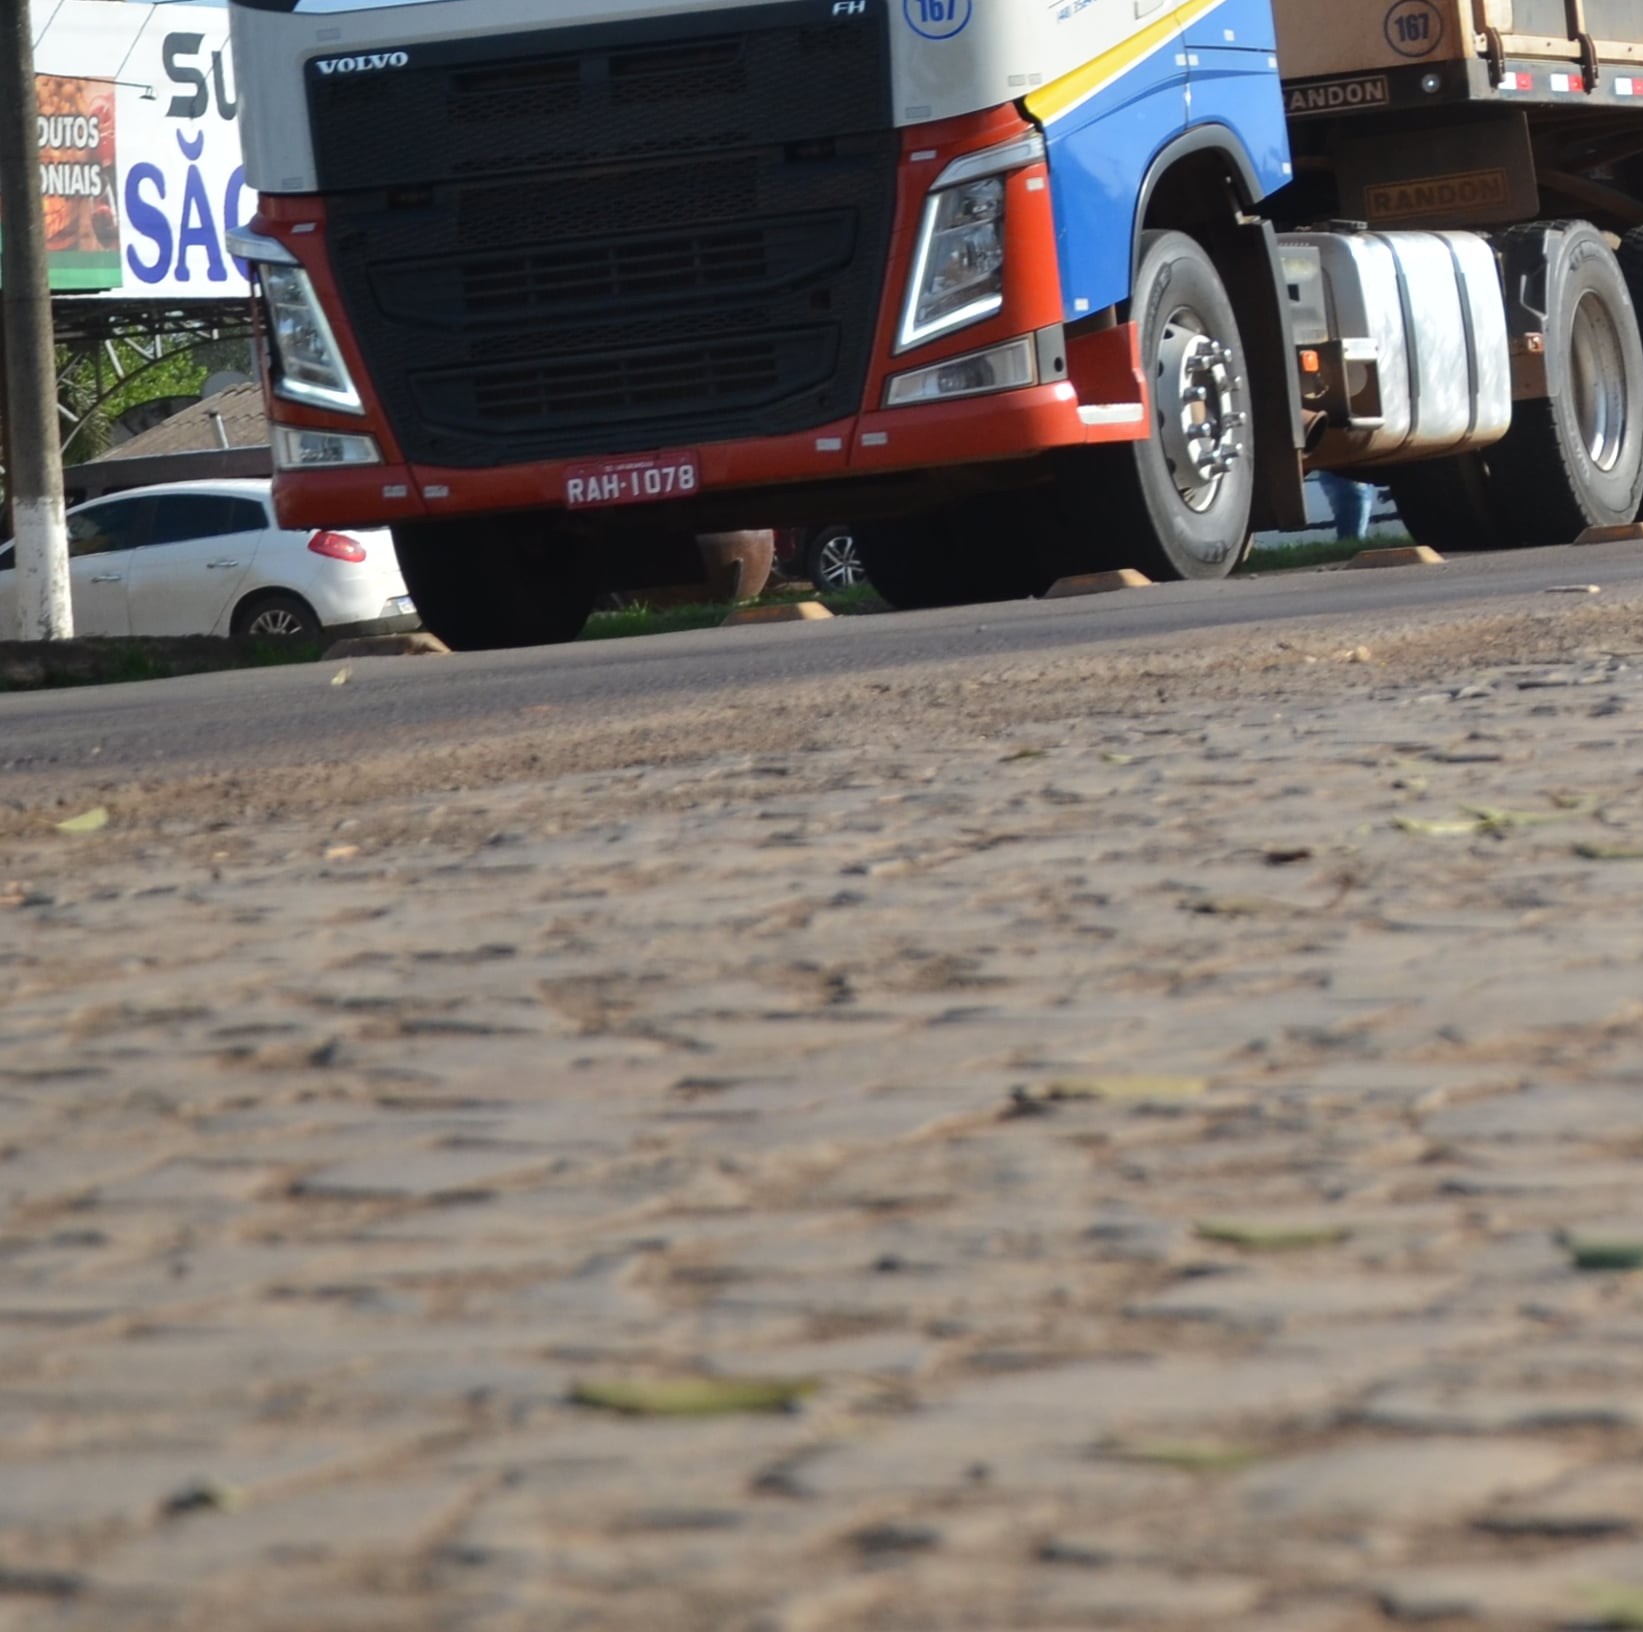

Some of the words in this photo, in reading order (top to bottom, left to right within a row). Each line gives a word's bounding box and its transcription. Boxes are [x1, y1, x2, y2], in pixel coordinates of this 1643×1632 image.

[832, 0, 867, 17] FH
[1394, 13, 1430, 43] 167
[315, 50, 410, 75] VOLVO
[1285, 79, 1384, 111] ANDON
[1373, 178, 1500, 212] RANDON
